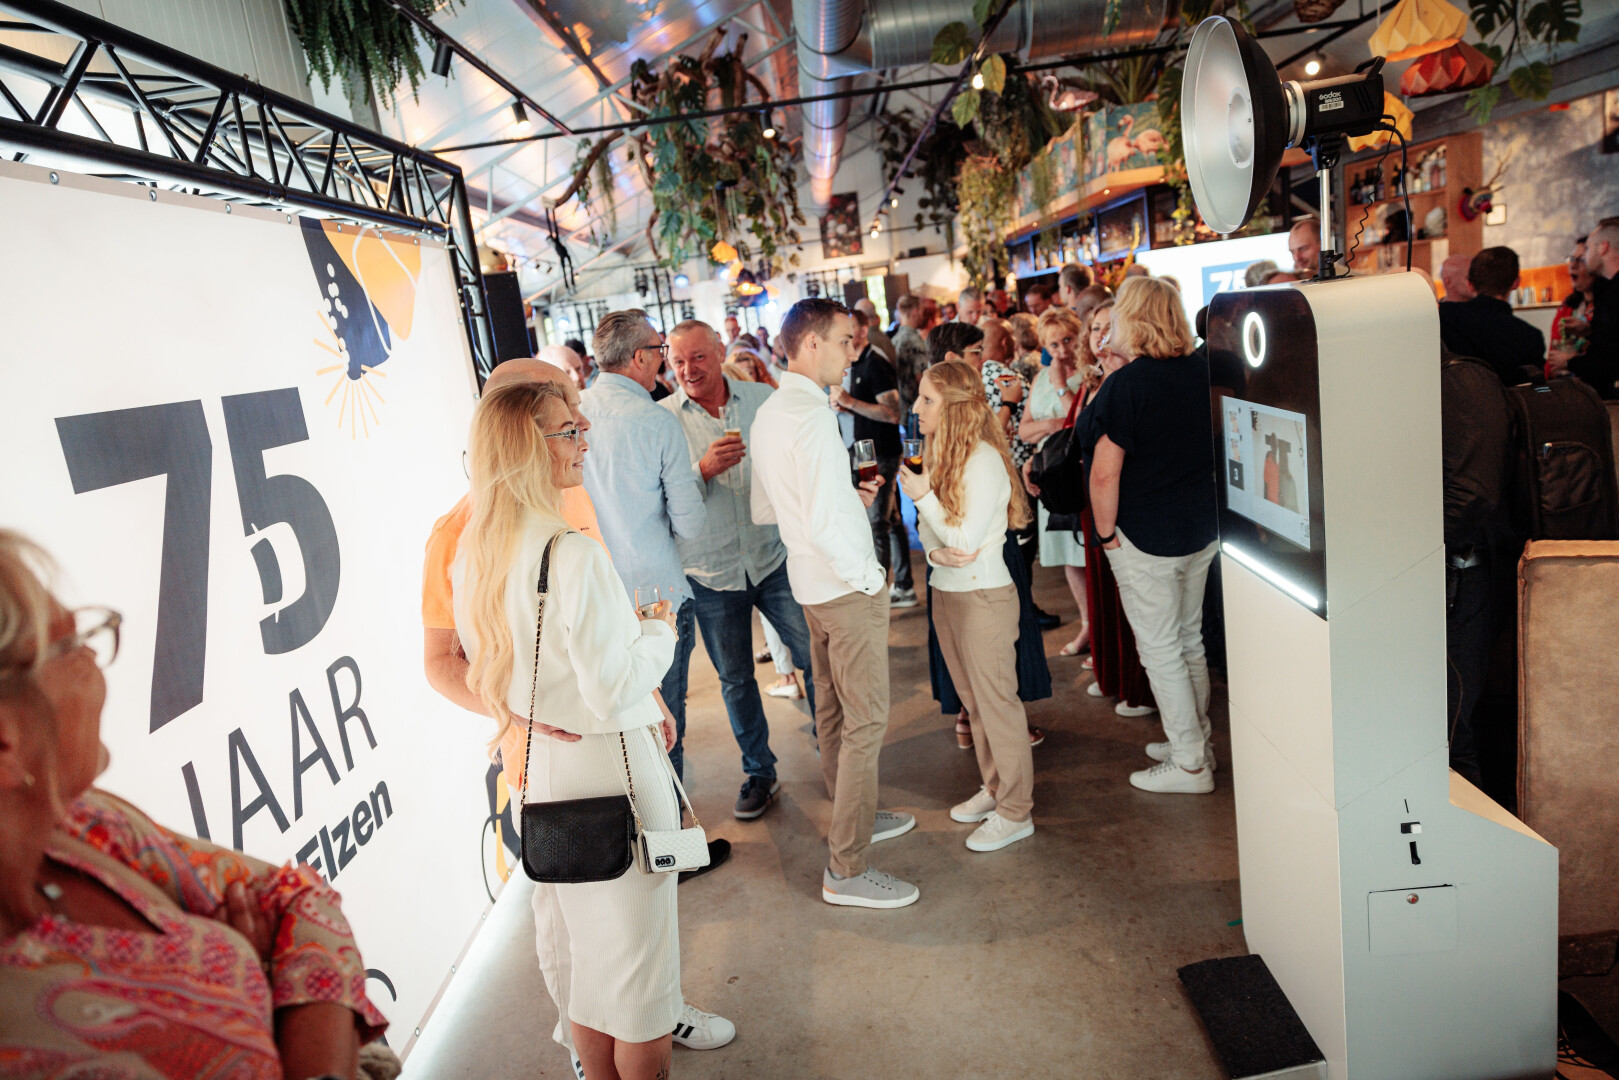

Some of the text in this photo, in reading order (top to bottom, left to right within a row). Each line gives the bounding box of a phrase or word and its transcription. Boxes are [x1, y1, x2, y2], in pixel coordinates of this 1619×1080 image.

[1318, 91, 1341, 100] Godox
[54, 386, 341, 735] 75
[295, 780, 393, 886] Elzen
